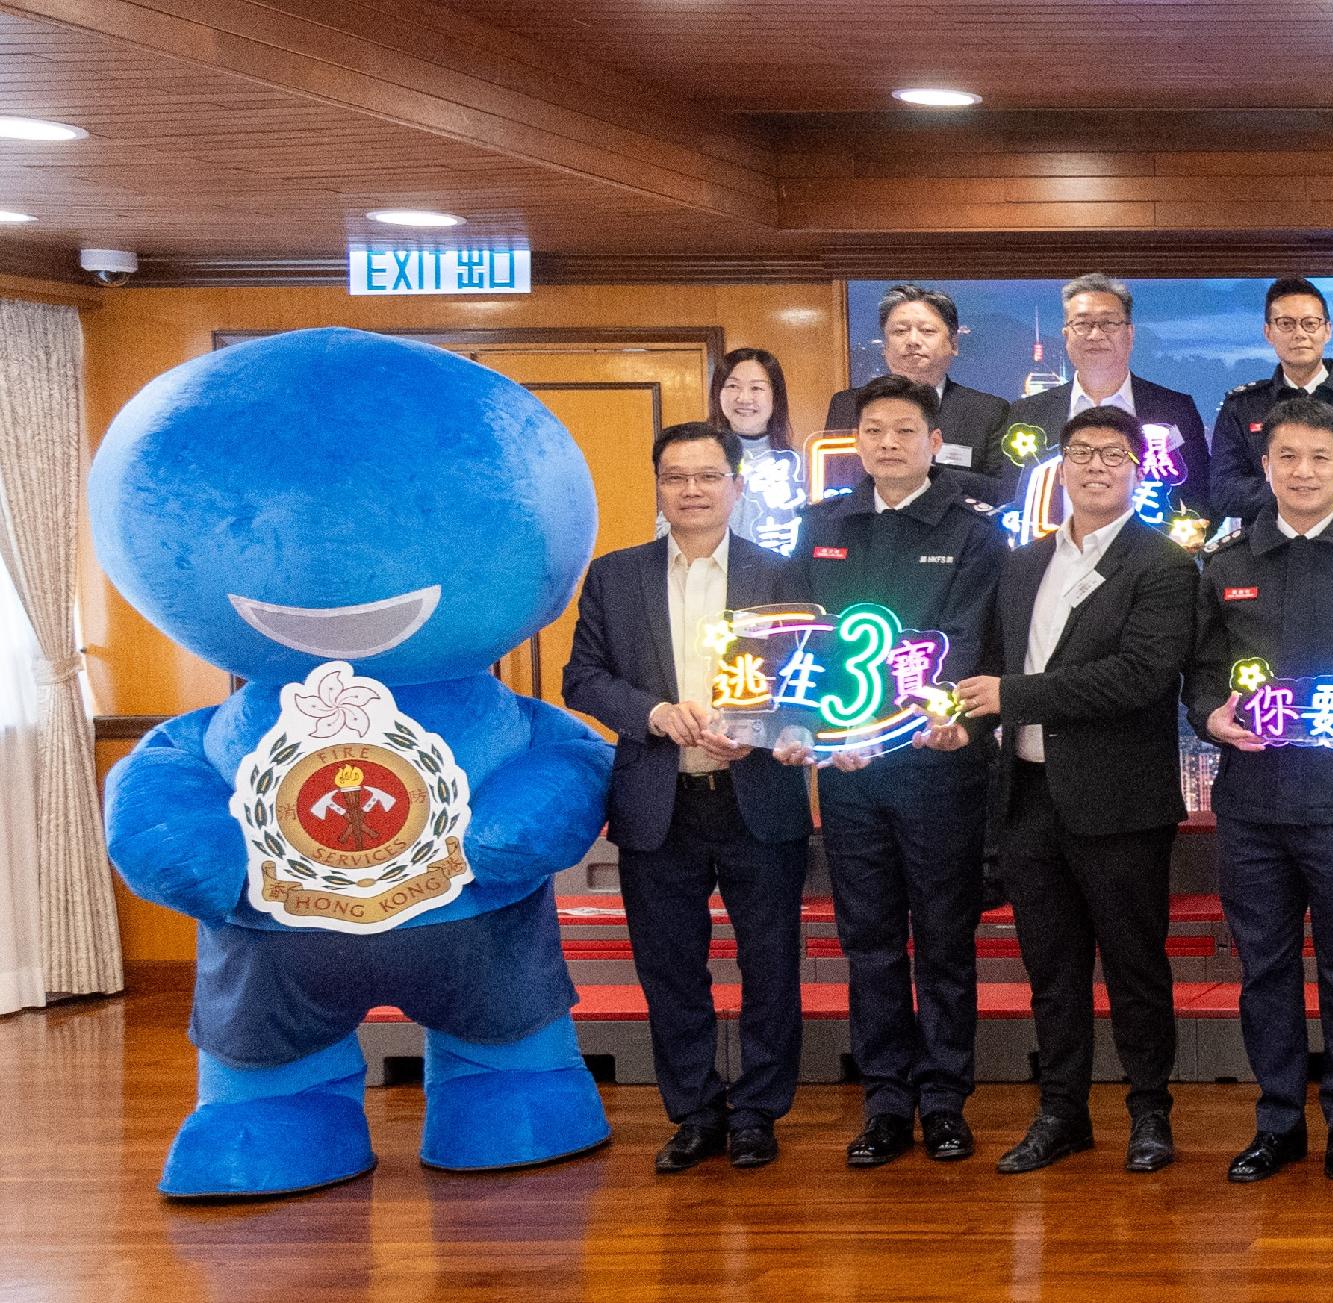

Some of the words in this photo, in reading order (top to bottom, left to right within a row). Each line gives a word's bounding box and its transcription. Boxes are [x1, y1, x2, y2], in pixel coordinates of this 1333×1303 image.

[366, 246, 446, 290] EXIT
[458, 246, 515, 289] 出口
[712, 612, 938, 728] 逃生3寶
[317, 747, 369, 763] FIRE
[313, 839, 408, 864] SERVICES
[295, 895, 365, 918] HONG
[380, 877, 442, 913] KONG
